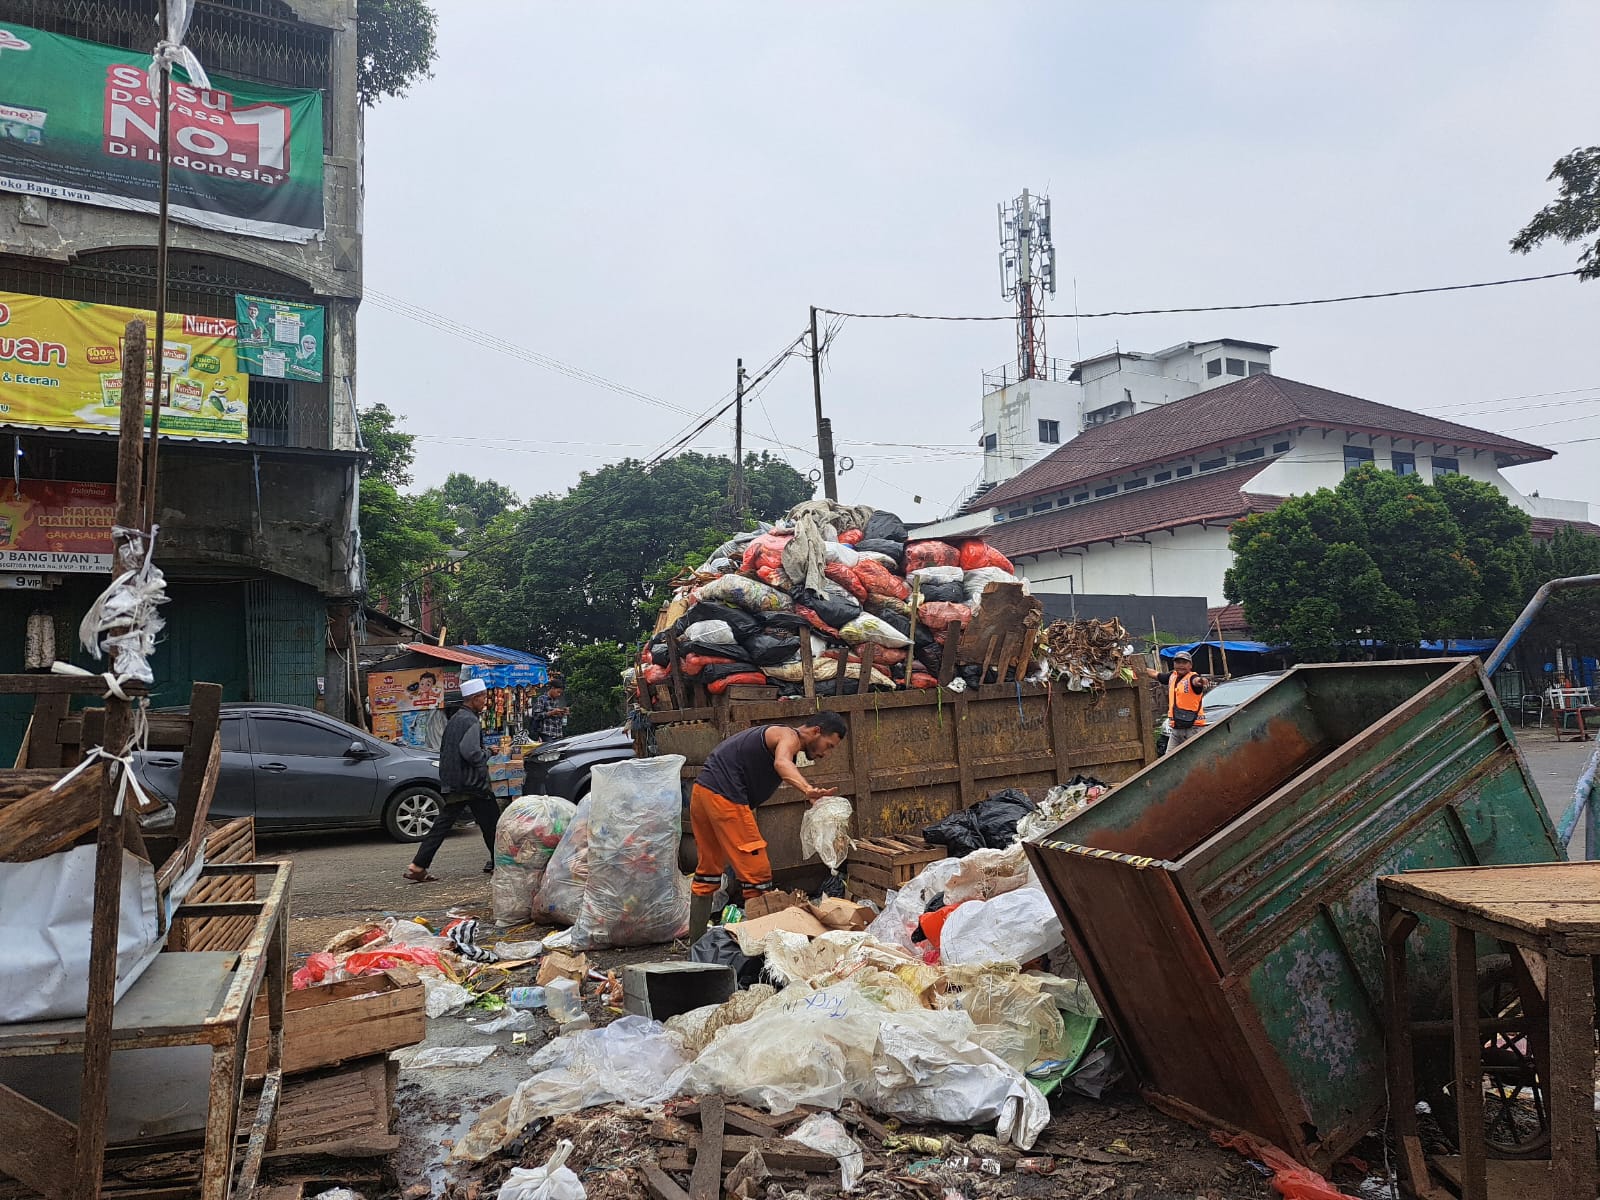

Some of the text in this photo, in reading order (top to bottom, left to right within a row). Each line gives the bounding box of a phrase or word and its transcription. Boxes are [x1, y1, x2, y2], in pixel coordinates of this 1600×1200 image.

[112, 67, 227, 111] Ssu
[109, 142, 136, 157] Di
[27, 182, 58, 196] Bang
[62, 188, 90, 200] Iwan
[185, 315, 237, 335] NutriSa
[3, 373, 60, 387] & Eceran
[9, 552, 48, 562] BANG
[52, 554, 89, 564] IWAN
[93, 555, 101, 564] 1
[16, 576, 41, 587] 9 VIP
